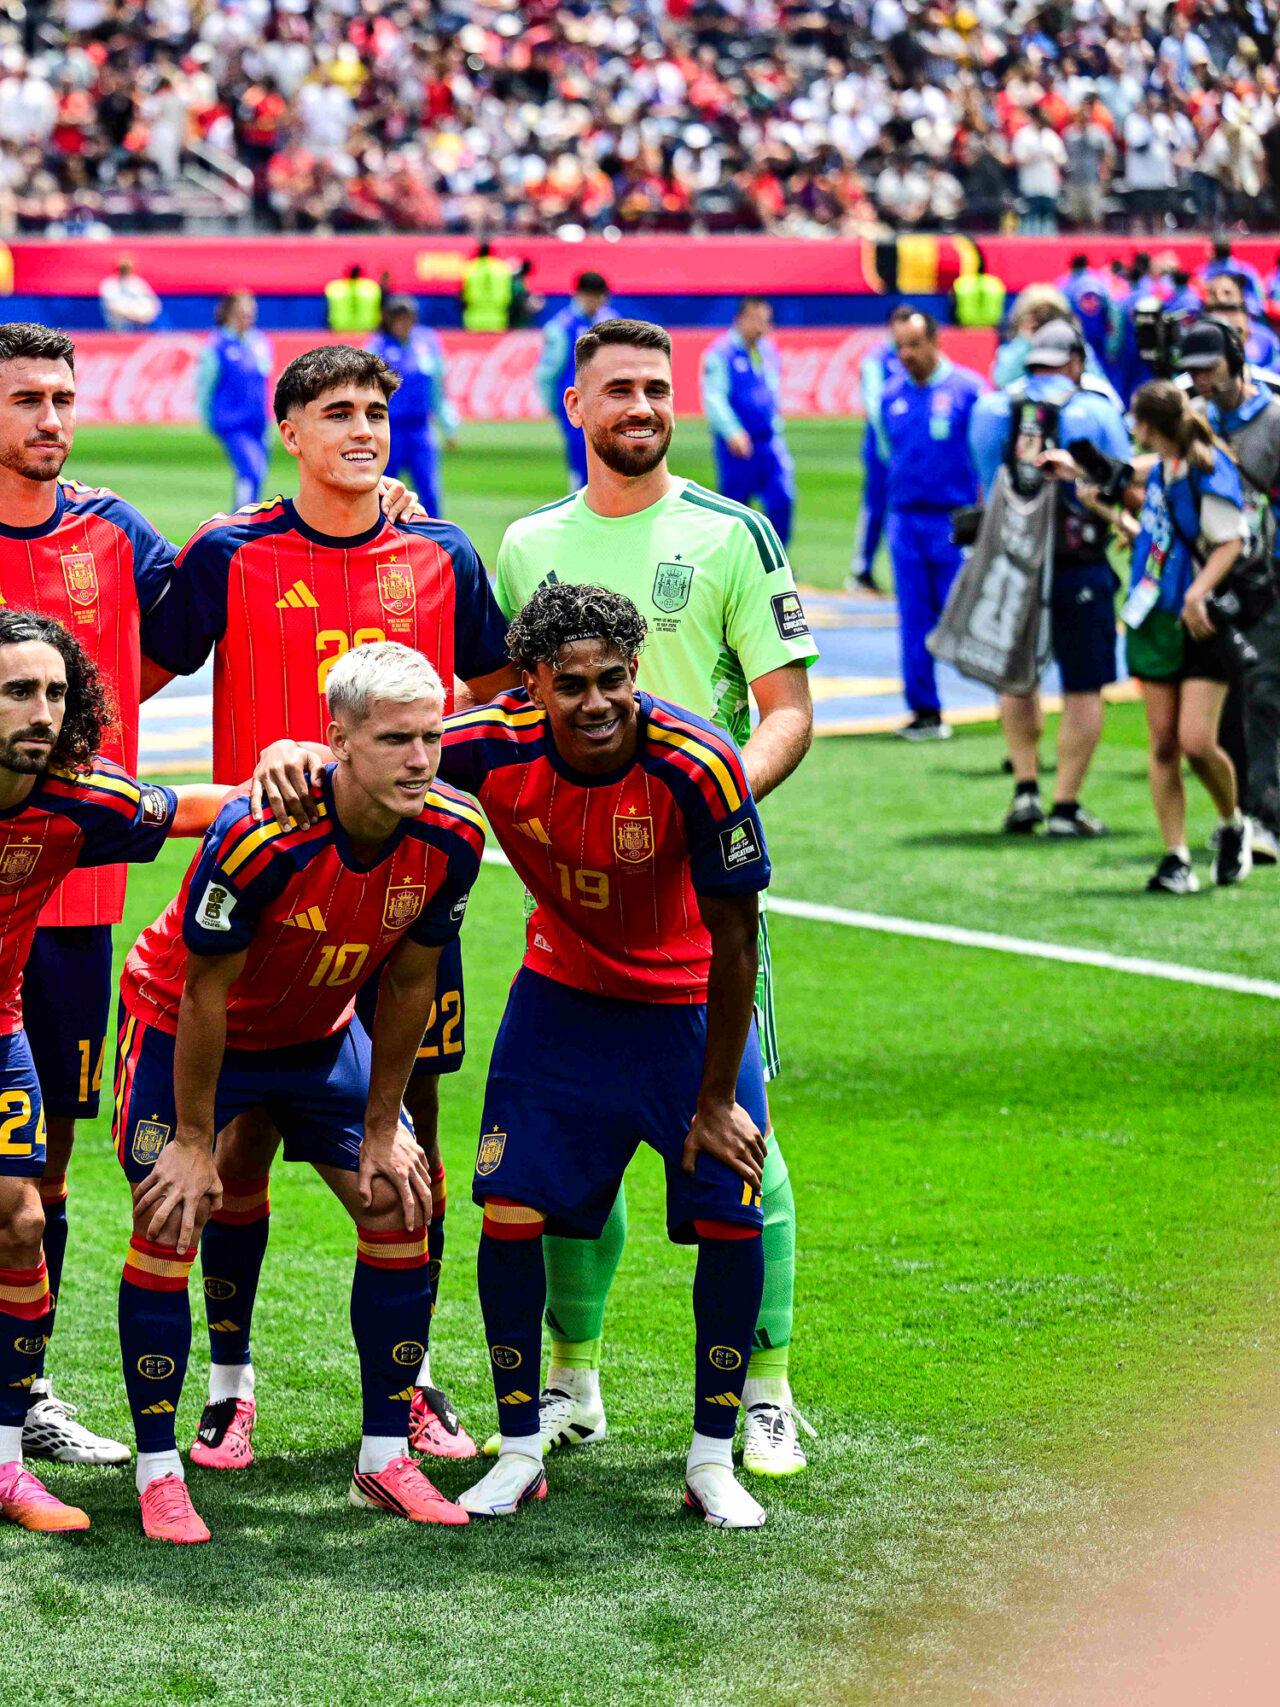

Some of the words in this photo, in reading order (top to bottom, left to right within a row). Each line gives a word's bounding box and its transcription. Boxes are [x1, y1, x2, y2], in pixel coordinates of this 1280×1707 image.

[728, 845, 755, 862] EDUCATION
[556, 862, 610, 909] 19
[308, 944, 370, 987] 10
